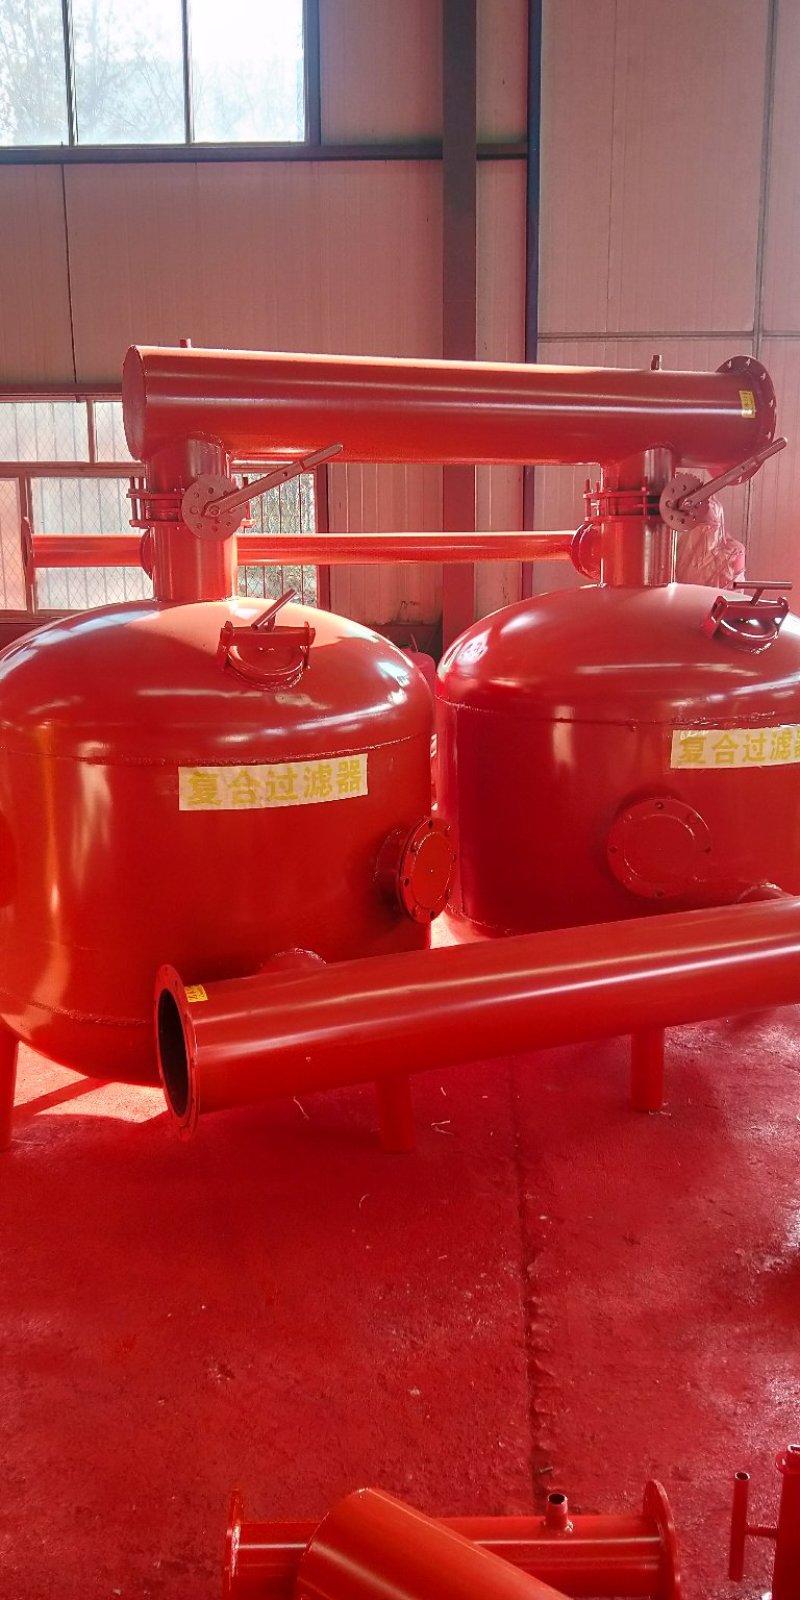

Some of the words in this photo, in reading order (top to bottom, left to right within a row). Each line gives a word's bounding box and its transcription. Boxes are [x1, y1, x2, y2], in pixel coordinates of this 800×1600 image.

[678, 730, 800, 764] 复合过滤
[187, 759, 361, 805] 复合过滤器
